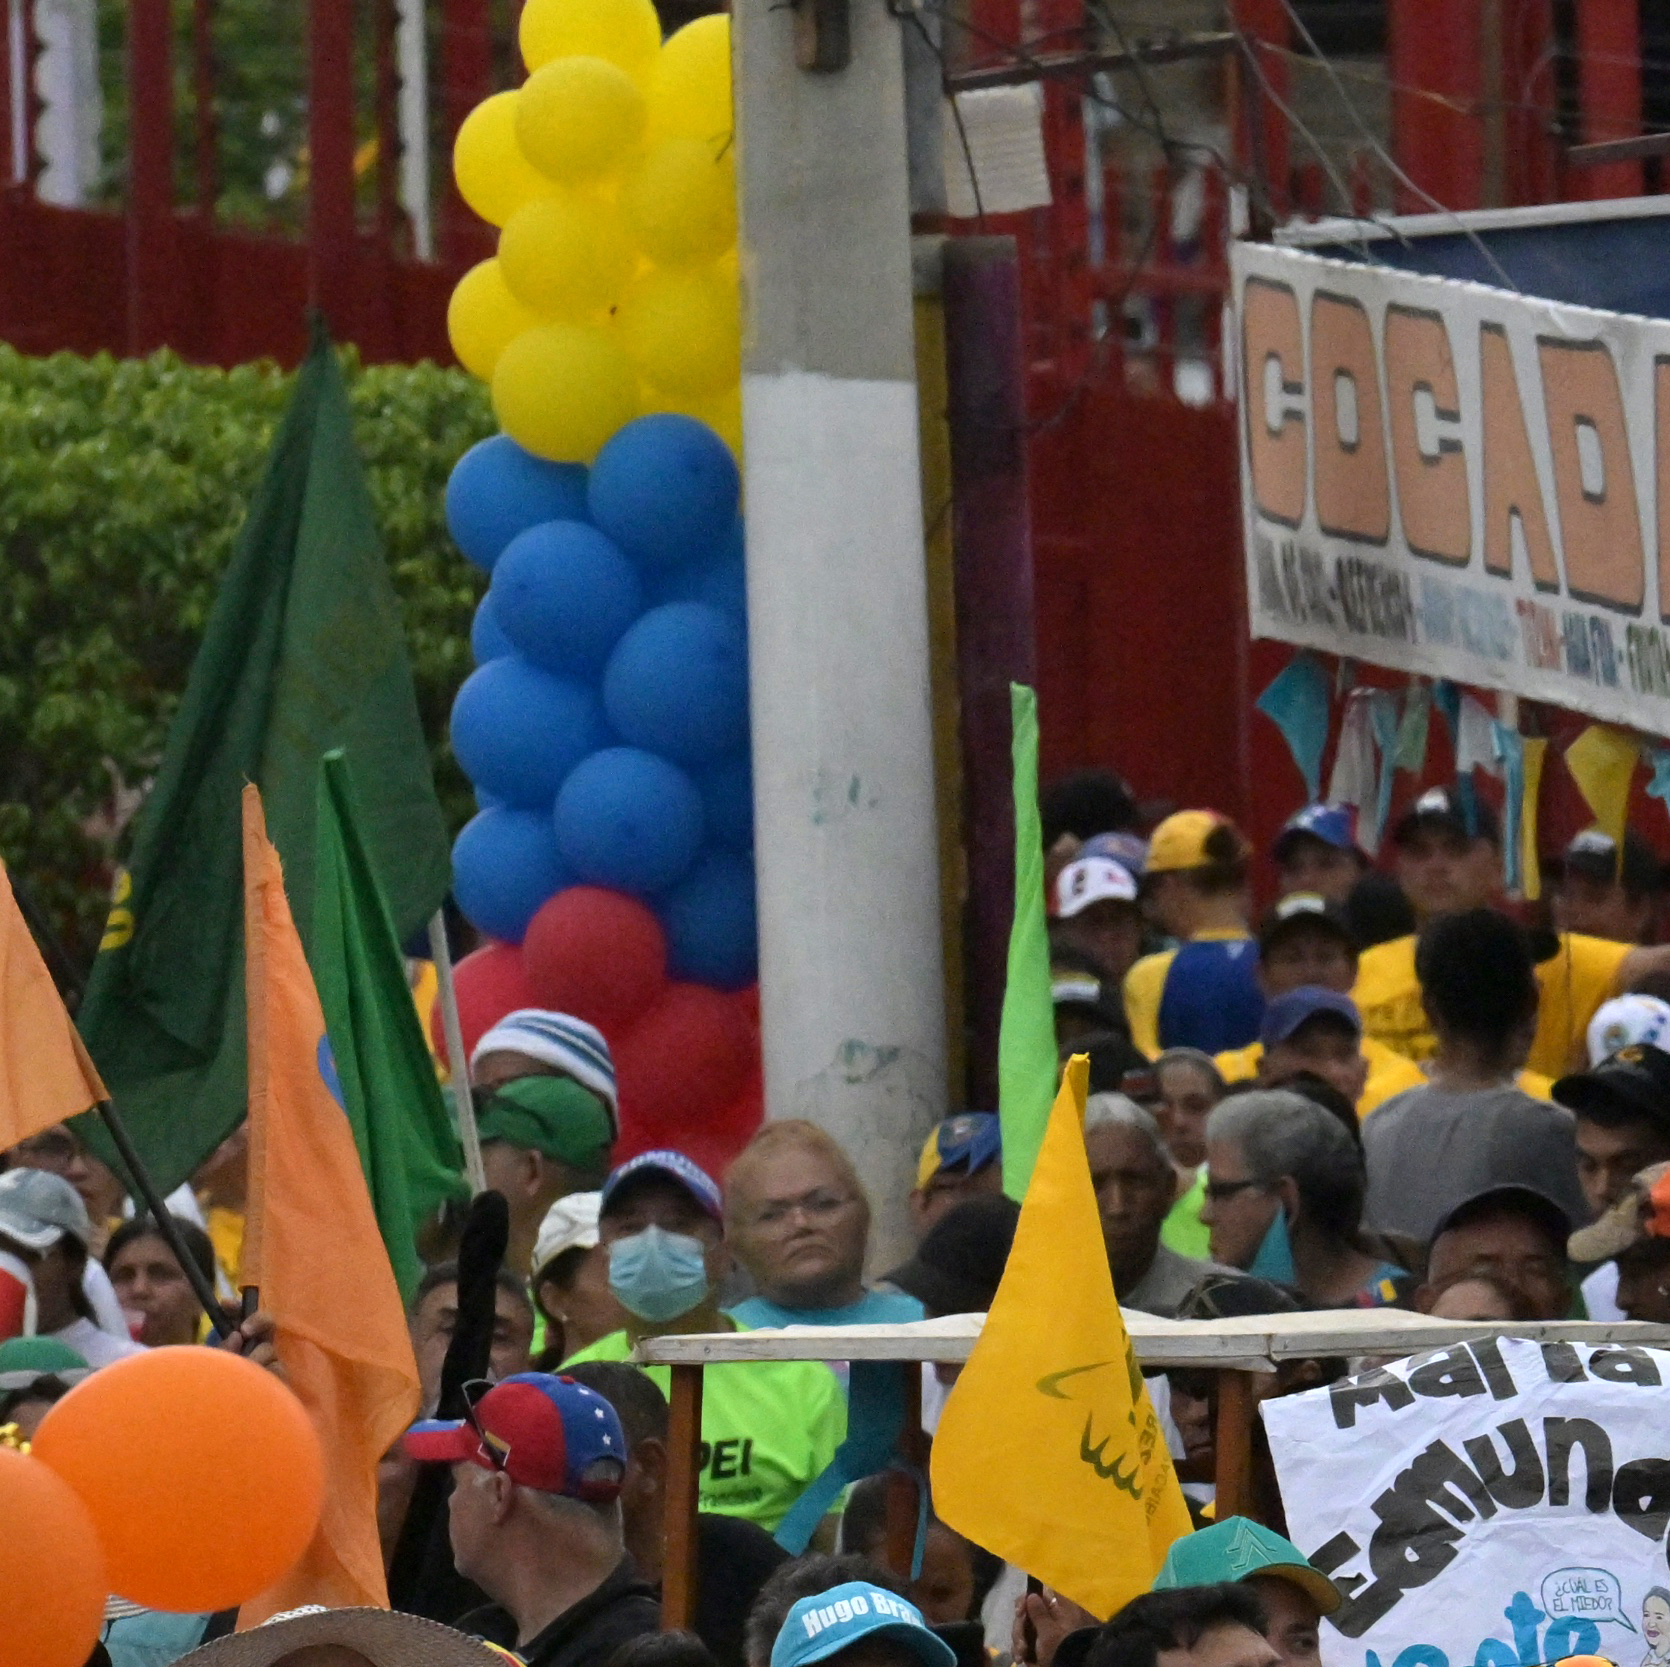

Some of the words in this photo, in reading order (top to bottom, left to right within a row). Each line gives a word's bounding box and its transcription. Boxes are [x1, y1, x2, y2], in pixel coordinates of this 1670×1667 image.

[1595, 1579, 1609, 1593] ES
[1552, 1598, 1569, 1612] EL
[801, 1595, 869, 1639] Hugo
[869, 1591, 922, 1628] Bra
